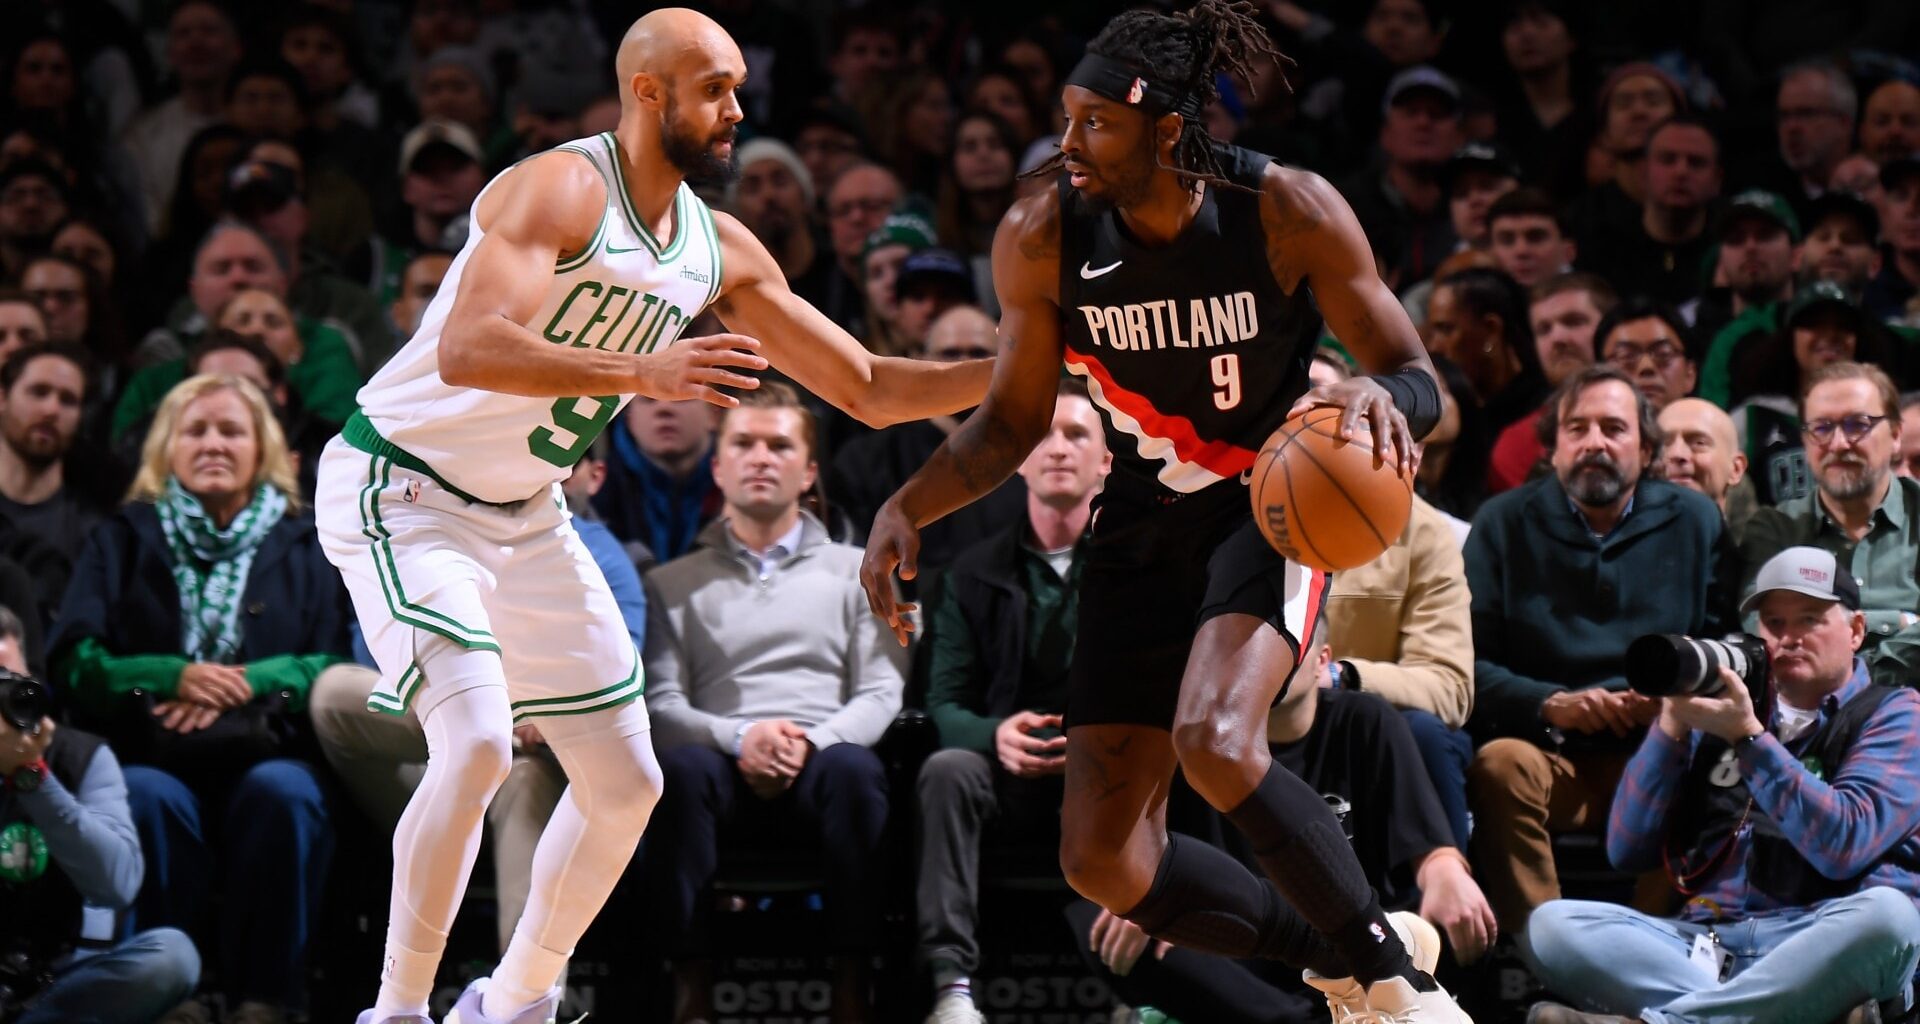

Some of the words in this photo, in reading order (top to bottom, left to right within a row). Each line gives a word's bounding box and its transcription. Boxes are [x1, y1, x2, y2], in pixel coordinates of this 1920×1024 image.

[679, 265, 709, 284] Amica
[1077, 291, 1259, 351] PORTLAND
[1210, 353, 1242, 411] 9
[527, 394, 621, 468] 9
[713, 980, 833, 1014] OSTO
[973, 976, 1112, 1009] OSTO
